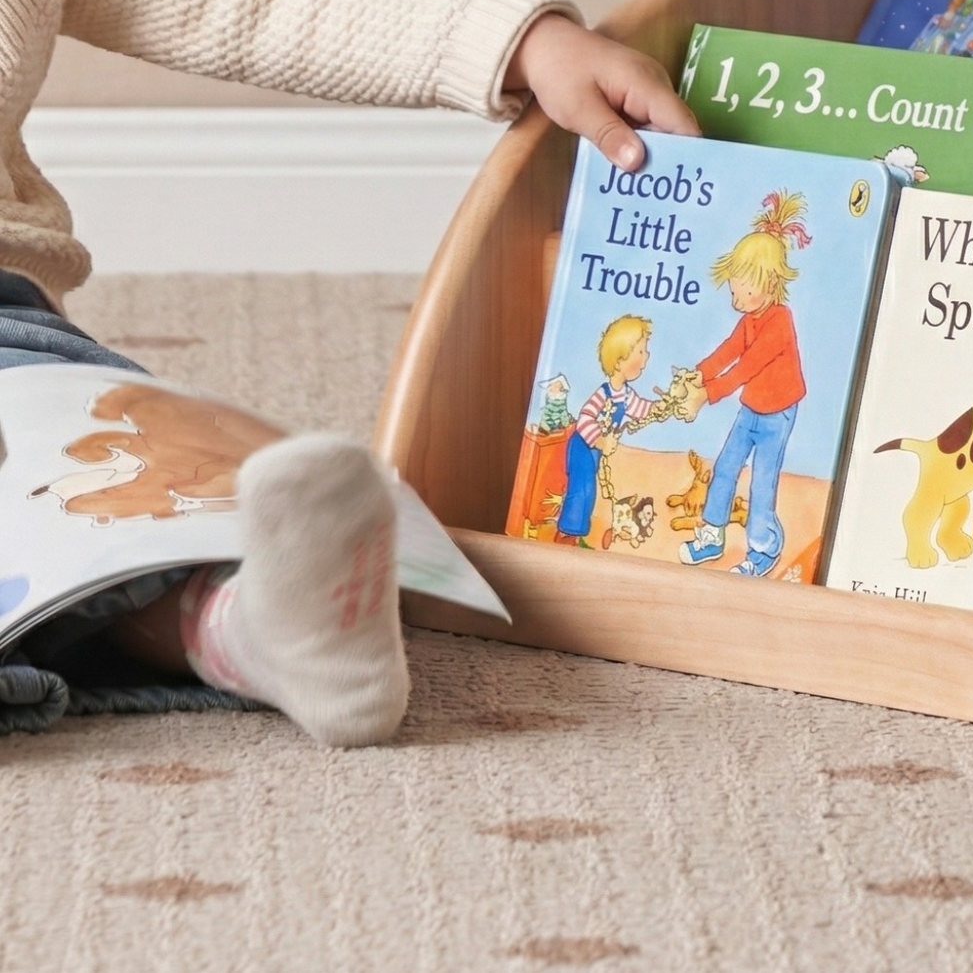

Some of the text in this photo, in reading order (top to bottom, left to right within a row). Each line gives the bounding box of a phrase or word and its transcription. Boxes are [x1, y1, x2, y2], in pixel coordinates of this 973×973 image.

[711, 56, 739, 113] 1,
[748, 61, 786, 118] 2,
[867, 84, 969, 131] Count
[599, 163, 714, 206] Jacob's
[606, 207, 692, 254] Little
[580, 254, 700, 306] Trouble
